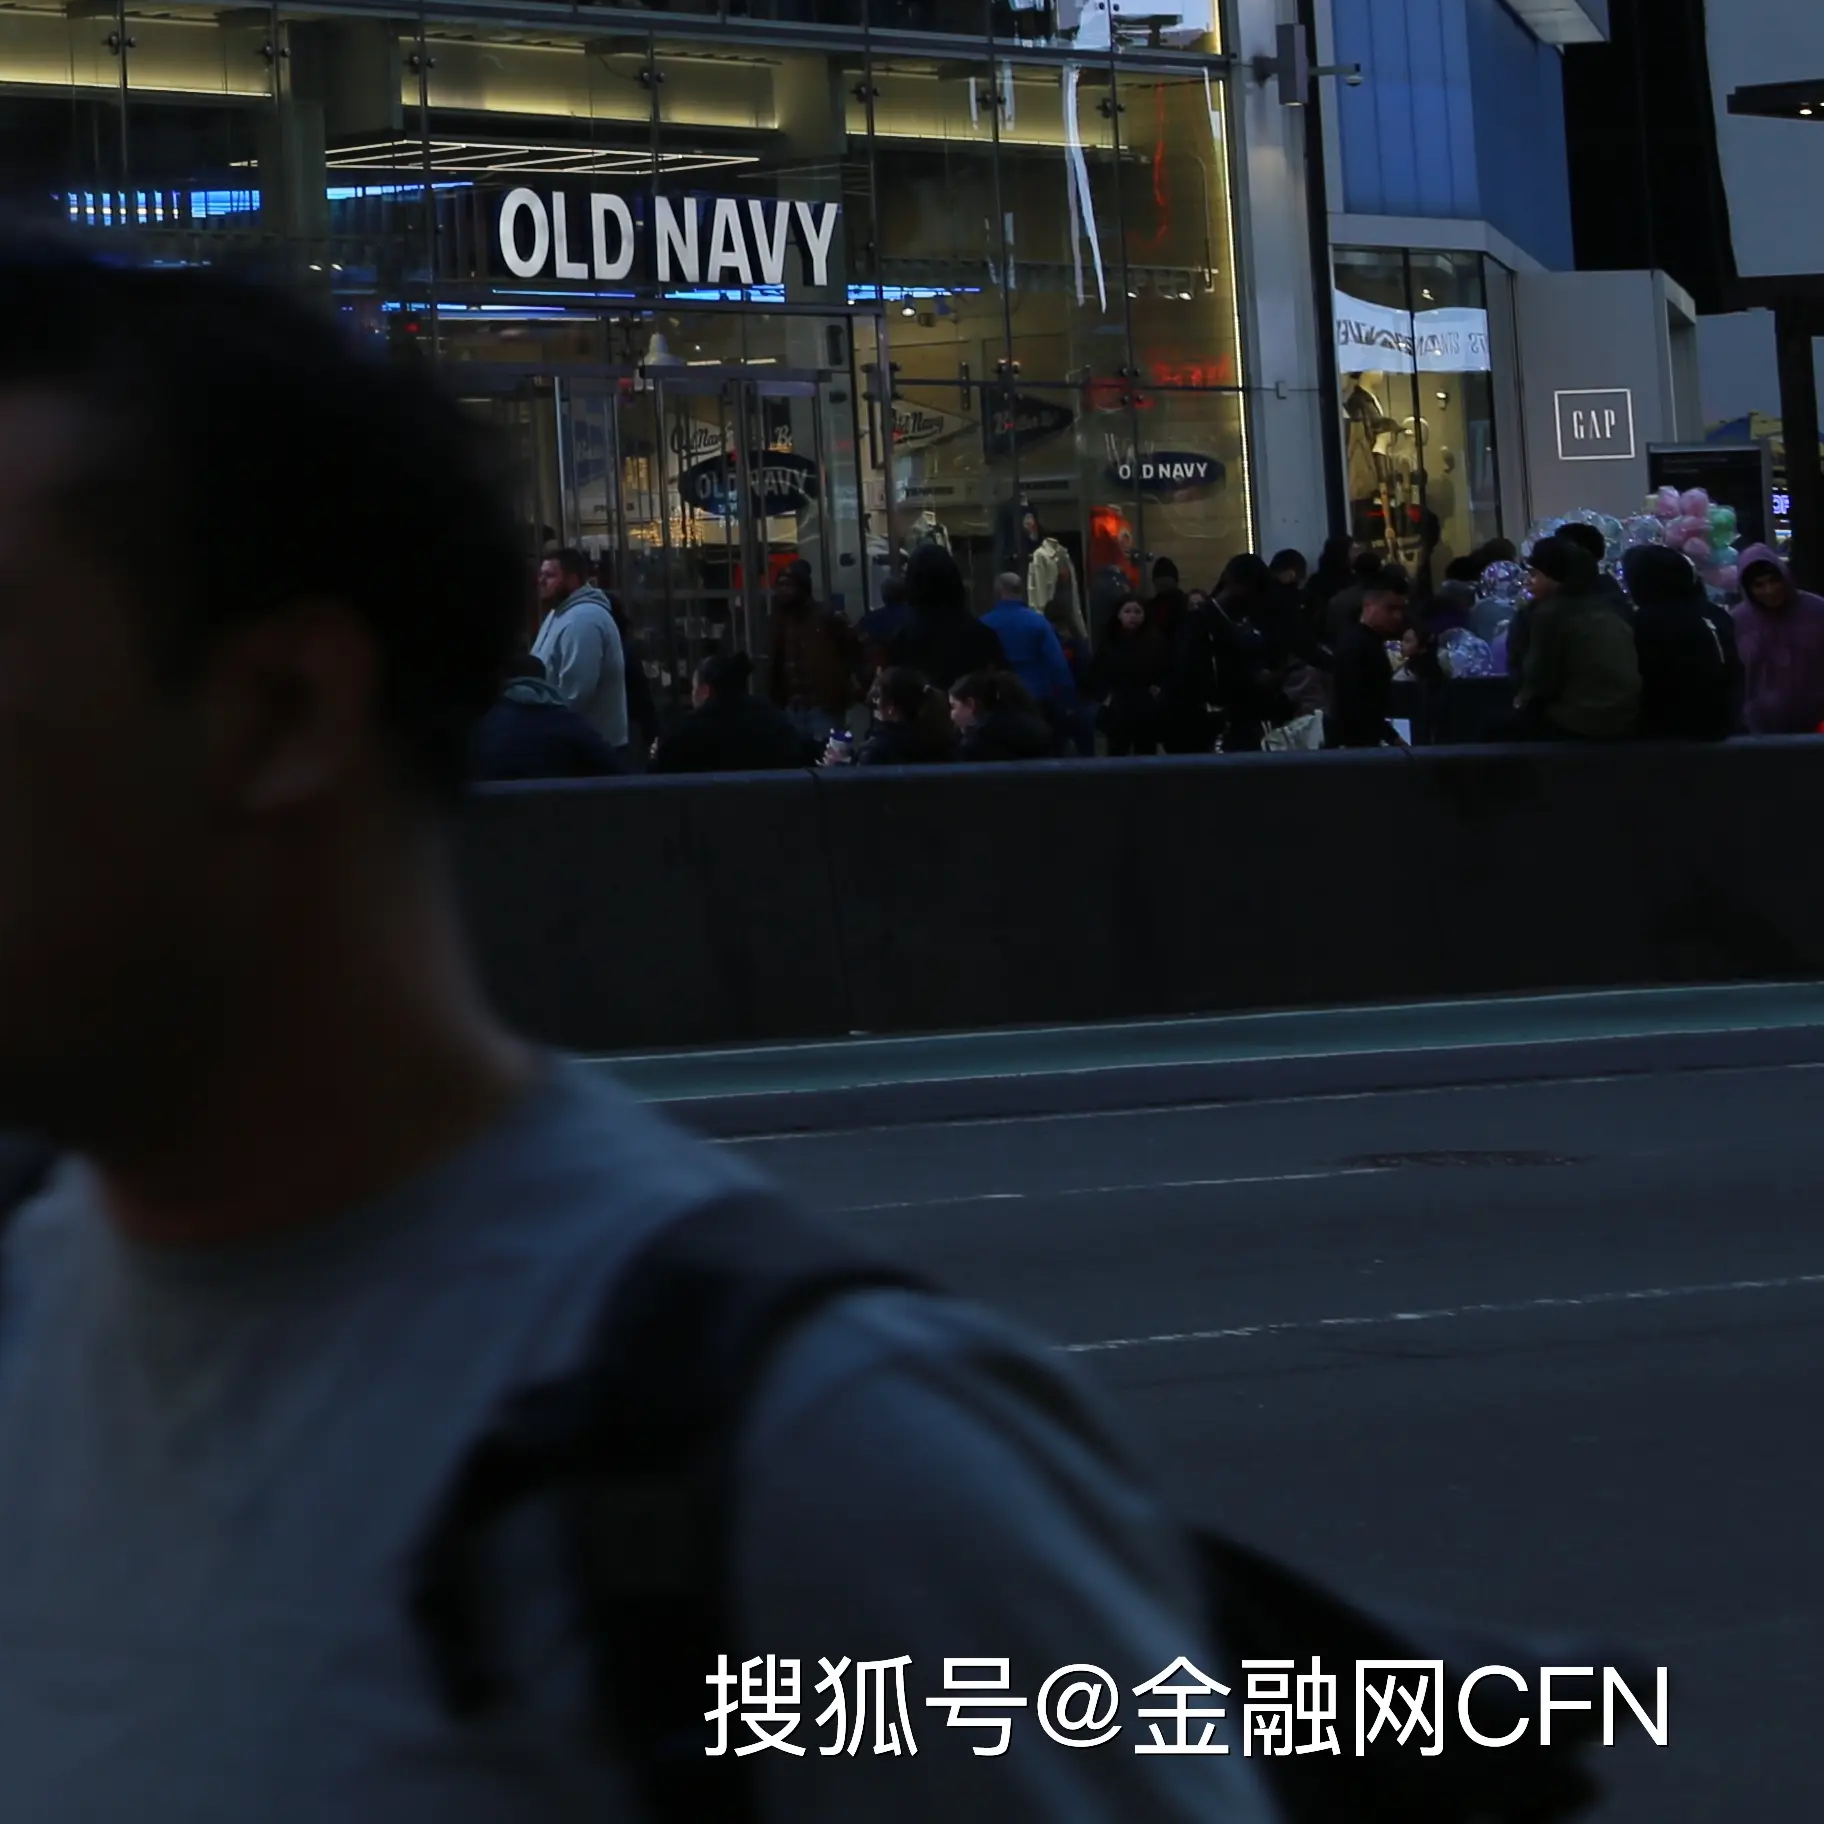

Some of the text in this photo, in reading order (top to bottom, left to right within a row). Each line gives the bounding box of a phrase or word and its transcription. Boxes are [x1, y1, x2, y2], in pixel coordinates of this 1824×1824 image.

[498, 187, 840, 287] OLD NAVY
[1572, 409, 1616, 439] GAP
[1118, 462, 1208, 480] OD NAVY
